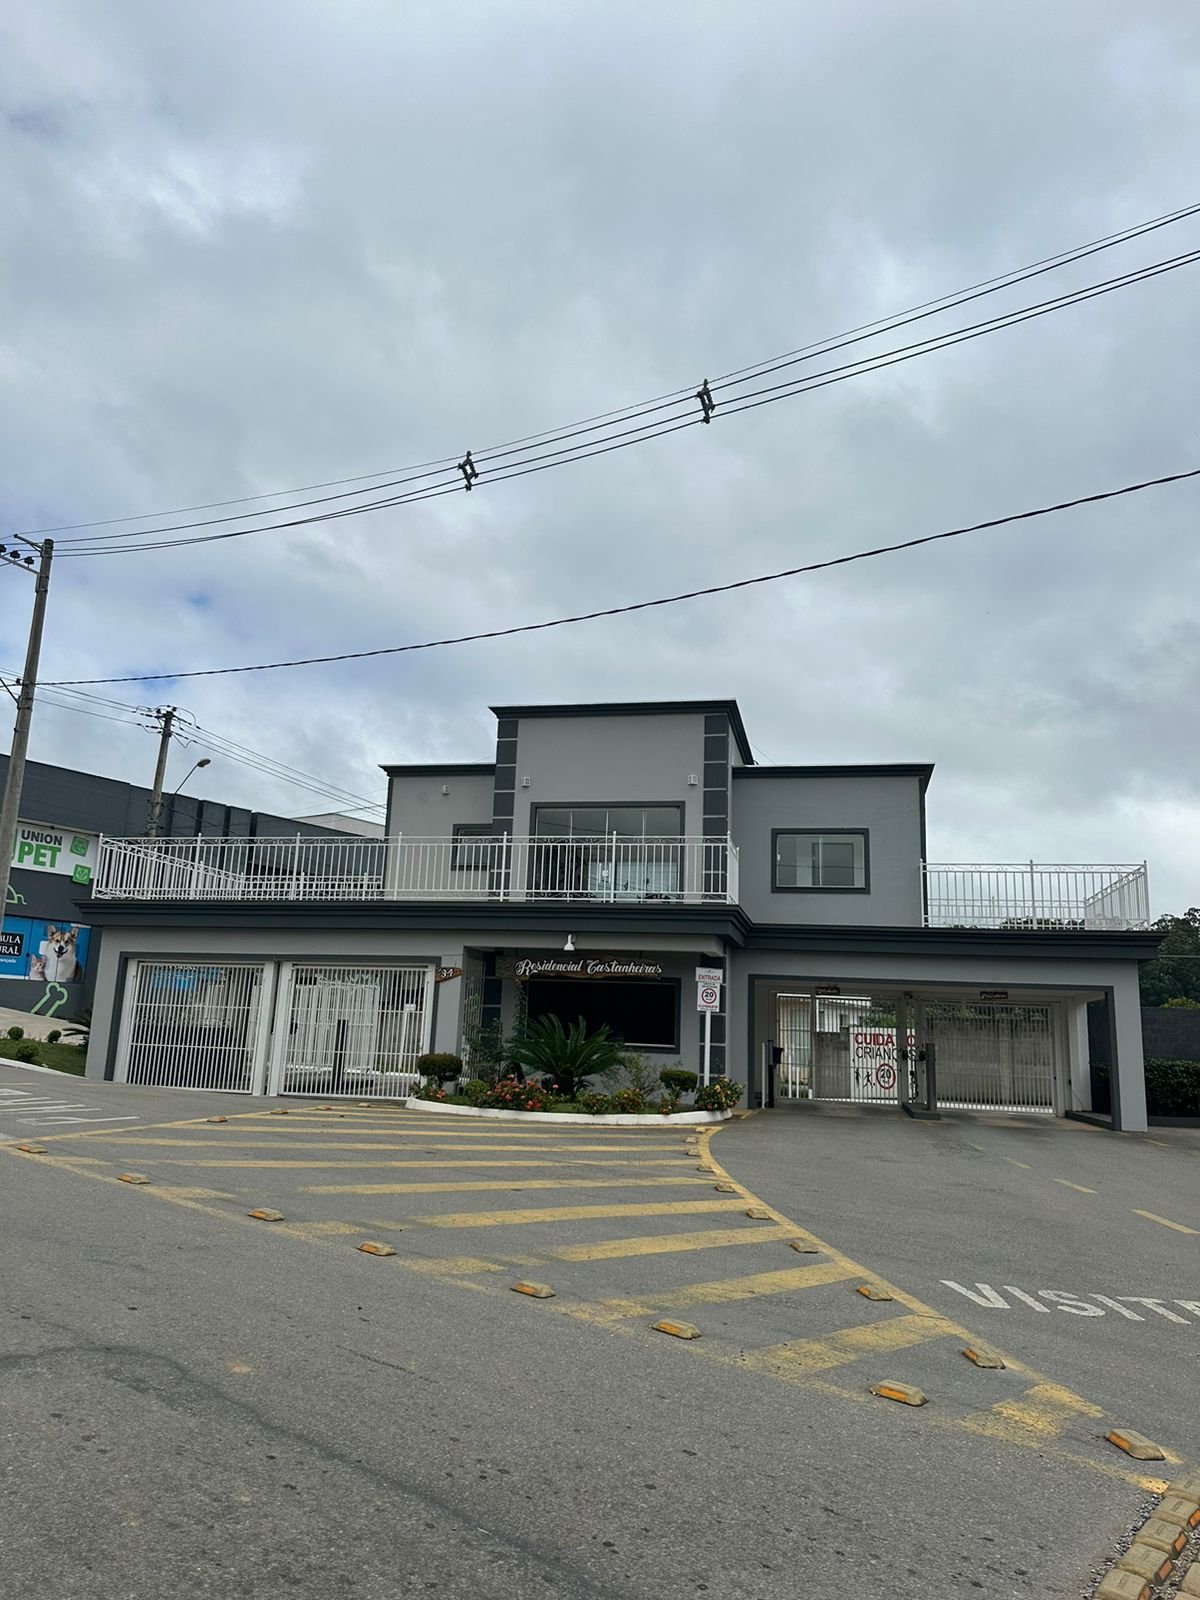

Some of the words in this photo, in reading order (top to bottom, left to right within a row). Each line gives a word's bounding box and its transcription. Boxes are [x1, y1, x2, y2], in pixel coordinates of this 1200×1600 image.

[21, 829, 63, 846] UNION
[17, 841, 62, 868] PET
[0, 934, 21, 944] ULA
[515, 958, 583, 976] Residencial
[586, 959, 662, 975] Castanheiras
[855, 1033, 916, 1047] CUIDAO
[856, 1046, 917, 1062] CRIANÇS
[880, 1068, 892, 1079] 20
